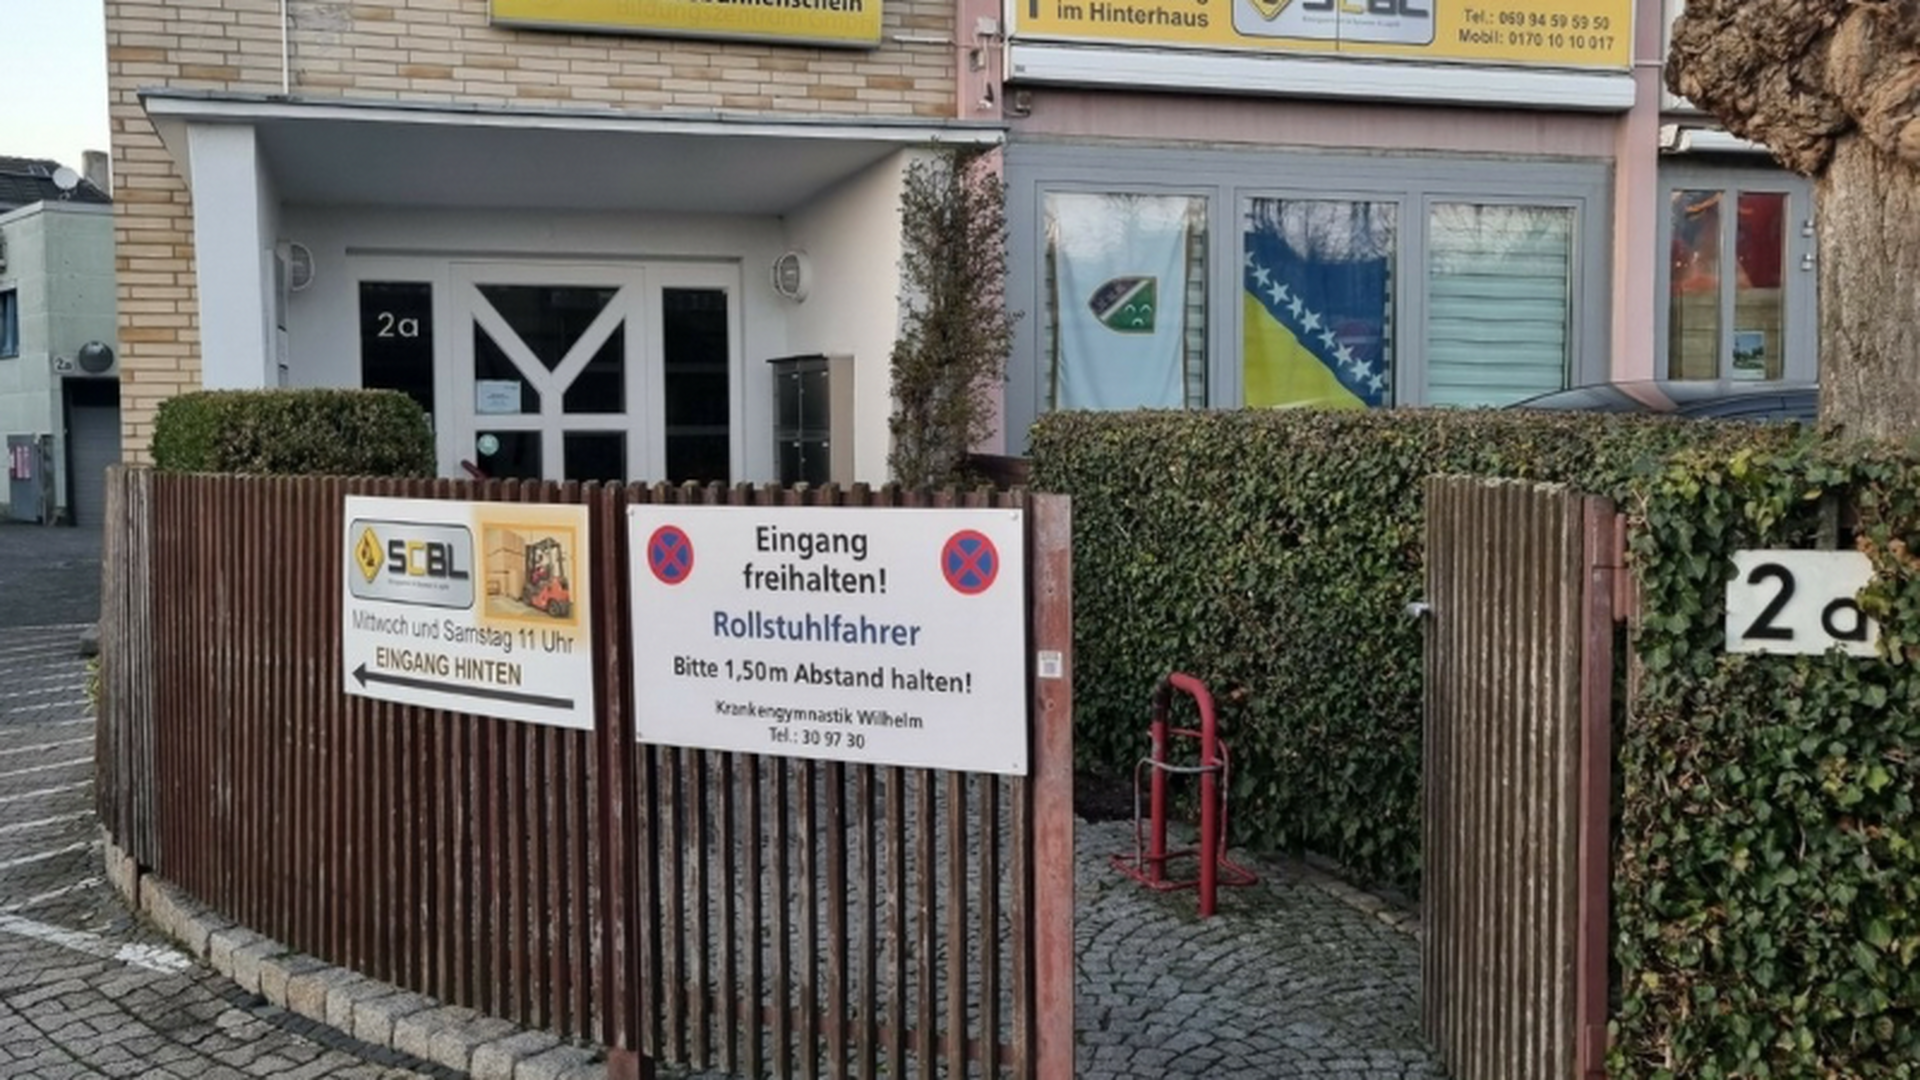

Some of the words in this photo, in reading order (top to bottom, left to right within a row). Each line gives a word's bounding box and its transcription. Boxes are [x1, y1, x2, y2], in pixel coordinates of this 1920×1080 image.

[1058, 0, 1083, 20] im
[1090, 2, 1209, 28] Hinterhaus
[1464, 9, 1494, 25] Tel.:
[1499, 11, 1525, 26] 069
[1528, 12, 1547, 27] 94
[1550, 13, 1568, 28] 59
[1571, 14, 1589, 30] 59
[1593, 16, 1610, 30] 50
[1459, 29, 1504, 44] Mobil:
[1509, 31, 1543, 47] 0170
[1548, 33, 1564, 48] 10
[1569, 35, 1585, 49] 10
[1589, 35, 1614, 50] 017
[377, 312, 419, 338] 2a
[756, 526, 868, 560] Eingang
[388, 539, 469, 580] SCBL
[743, 563, 887, 595] freihalten!
[352, 610, 408, 637] Mittwoch
[412, 619, 439, 640] und
[444, 619, 512, 653] Samstag
[519, 629, 536, 650] 11
[542, 630, 574, 654] Uhr
[713, 610, 921, 647] Rollstuhlfahrer
[376, 646, 450, 677] EINGANG
[455, 660, 521, 686] HINTEN
[674, 656, 718, 679] Bitte
[725, 660, 788, 685] 1,50m
[795, 665, 884, 690] Abstand
[892, 668, 972, 694] halten!
[715, 700, 853, 727] Krankengymnastik
[858, 709, 924, 730] Wilhelm
[769, 726, 798, 744] Tel.:
[802, 729, 821, 746] 30
[825, 731, 842, 748] 97
[847, 733, 865, 749] 30
